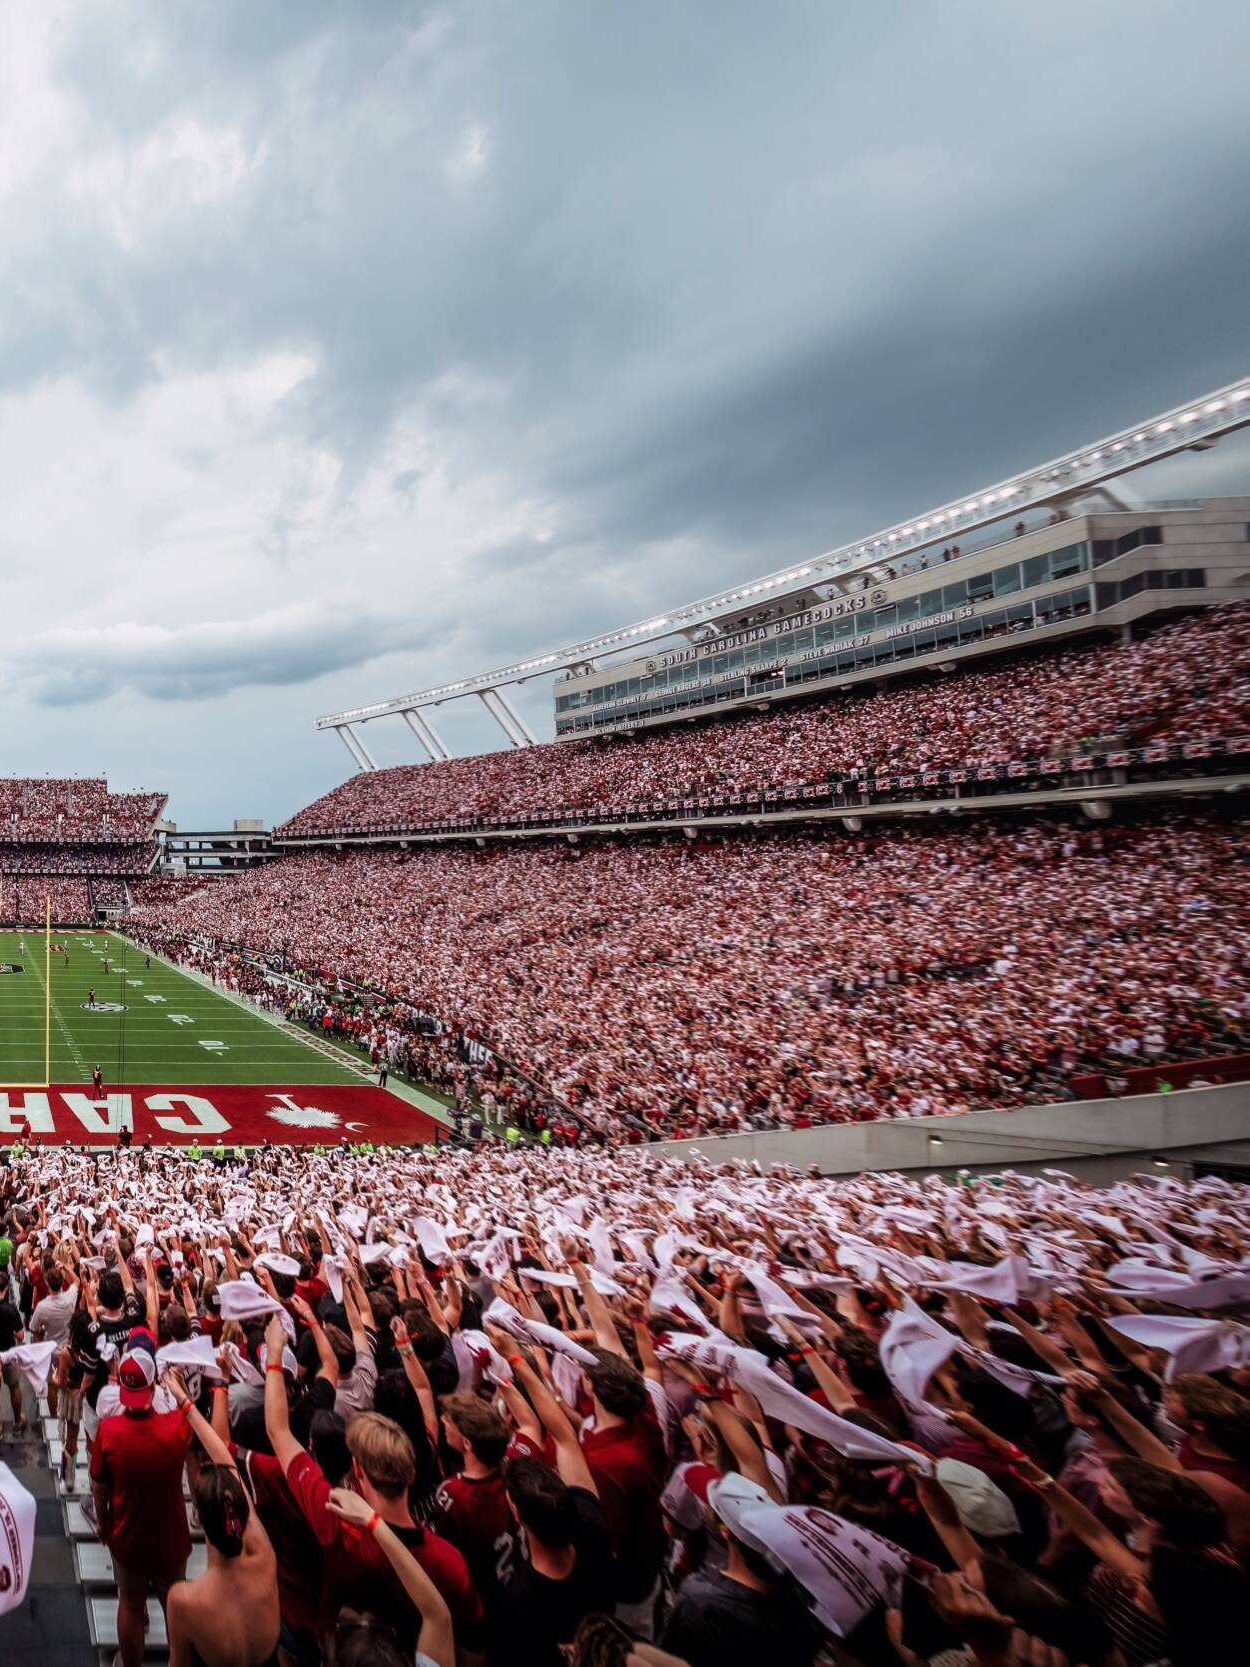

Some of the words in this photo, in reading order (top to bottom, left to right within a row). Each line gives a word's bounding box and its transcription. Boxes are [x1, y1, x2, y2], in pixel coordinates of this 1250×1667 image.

[660, 648, 698, 667] SOUTH
[702, 627, 766, 655] CAROLINA
[773, 596, 866, 635] GAMECOCKS
[886, 624, 909, 638] MIKE
[910, 612, 954, 632] JOHNSON
[959, 607, 974, 617] 56
[800, 646, 823, 661] STEVE
[824, 641, 854, 656] WADIAK
[857, 635, 870, 646] 37
[719, 667, 749, 681] STERLING
[750, 660, 778, 674] SHARPE
[781, 658, 789, 666] 2
[198, 1040, 231, 1050] 10
